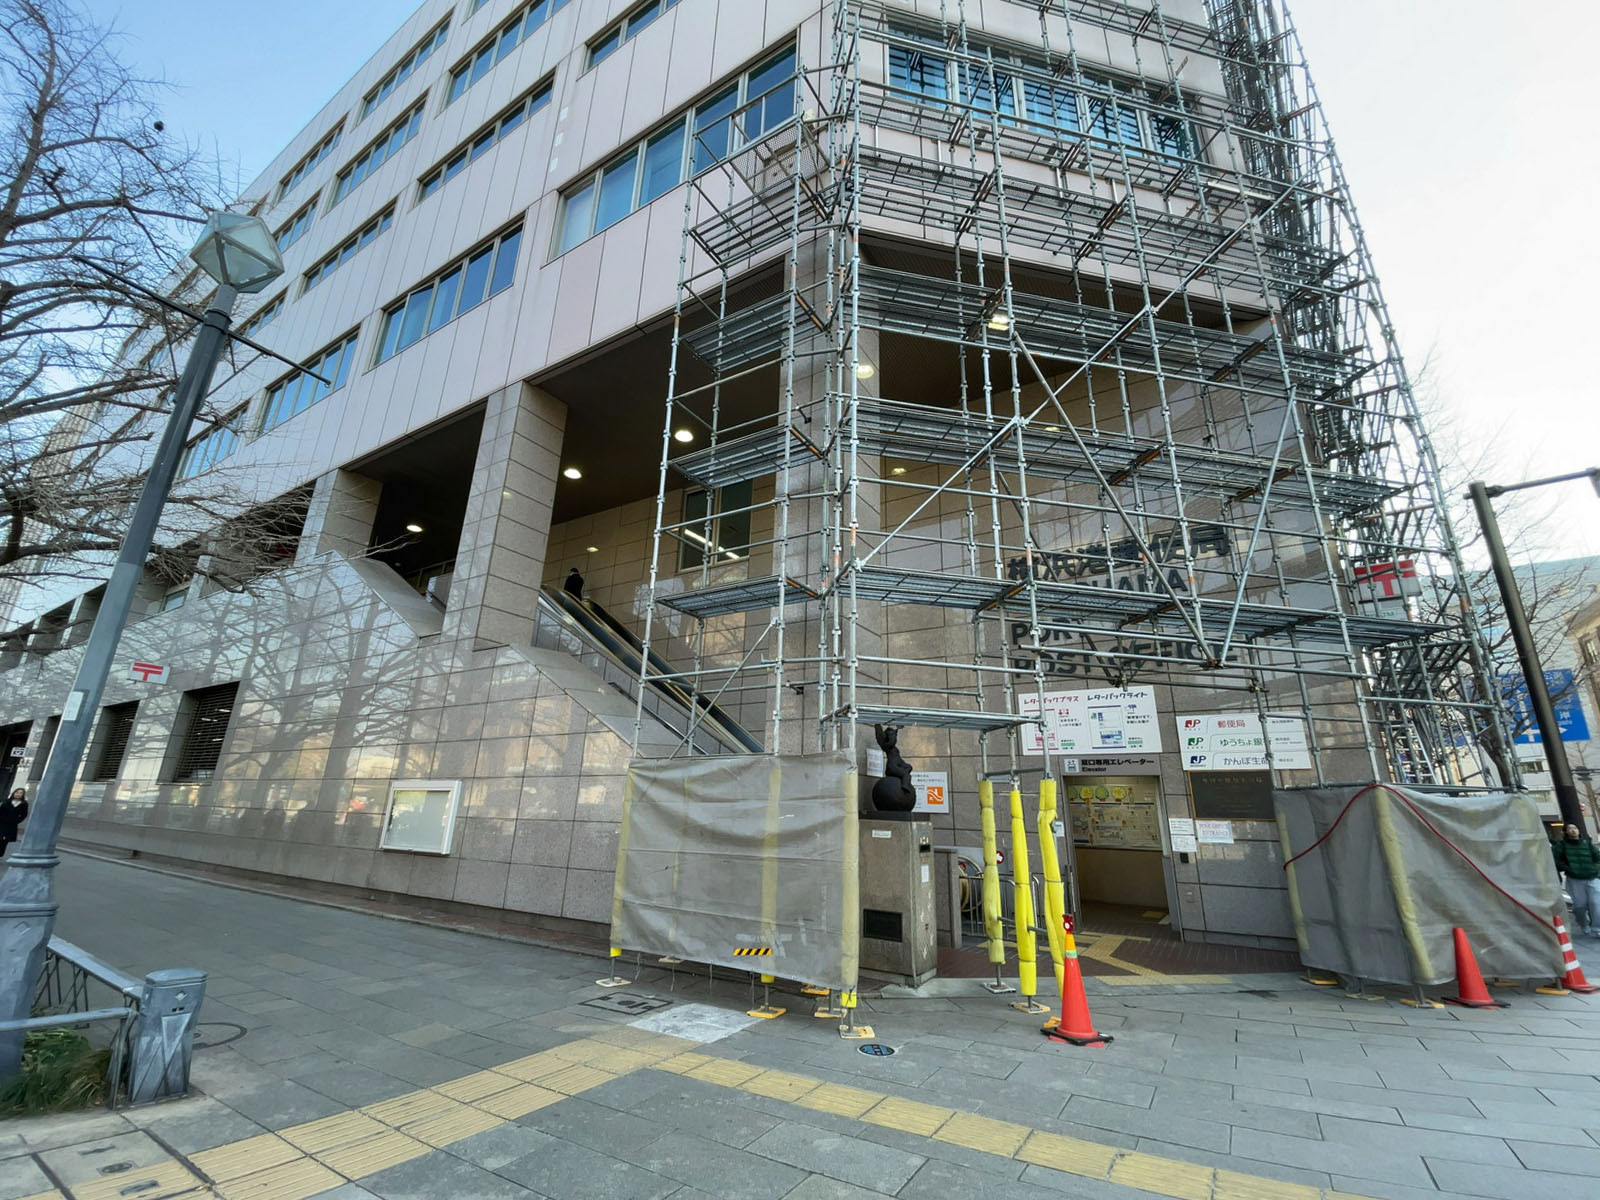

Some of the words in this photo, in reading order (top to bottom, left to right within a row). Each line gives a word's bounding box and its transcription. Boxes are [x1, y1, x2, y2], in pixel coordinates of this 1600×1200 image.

[1217, 719, 1246, 728] 郵便局
[1220, 737, 1272, 747] ゆうちょ銀
